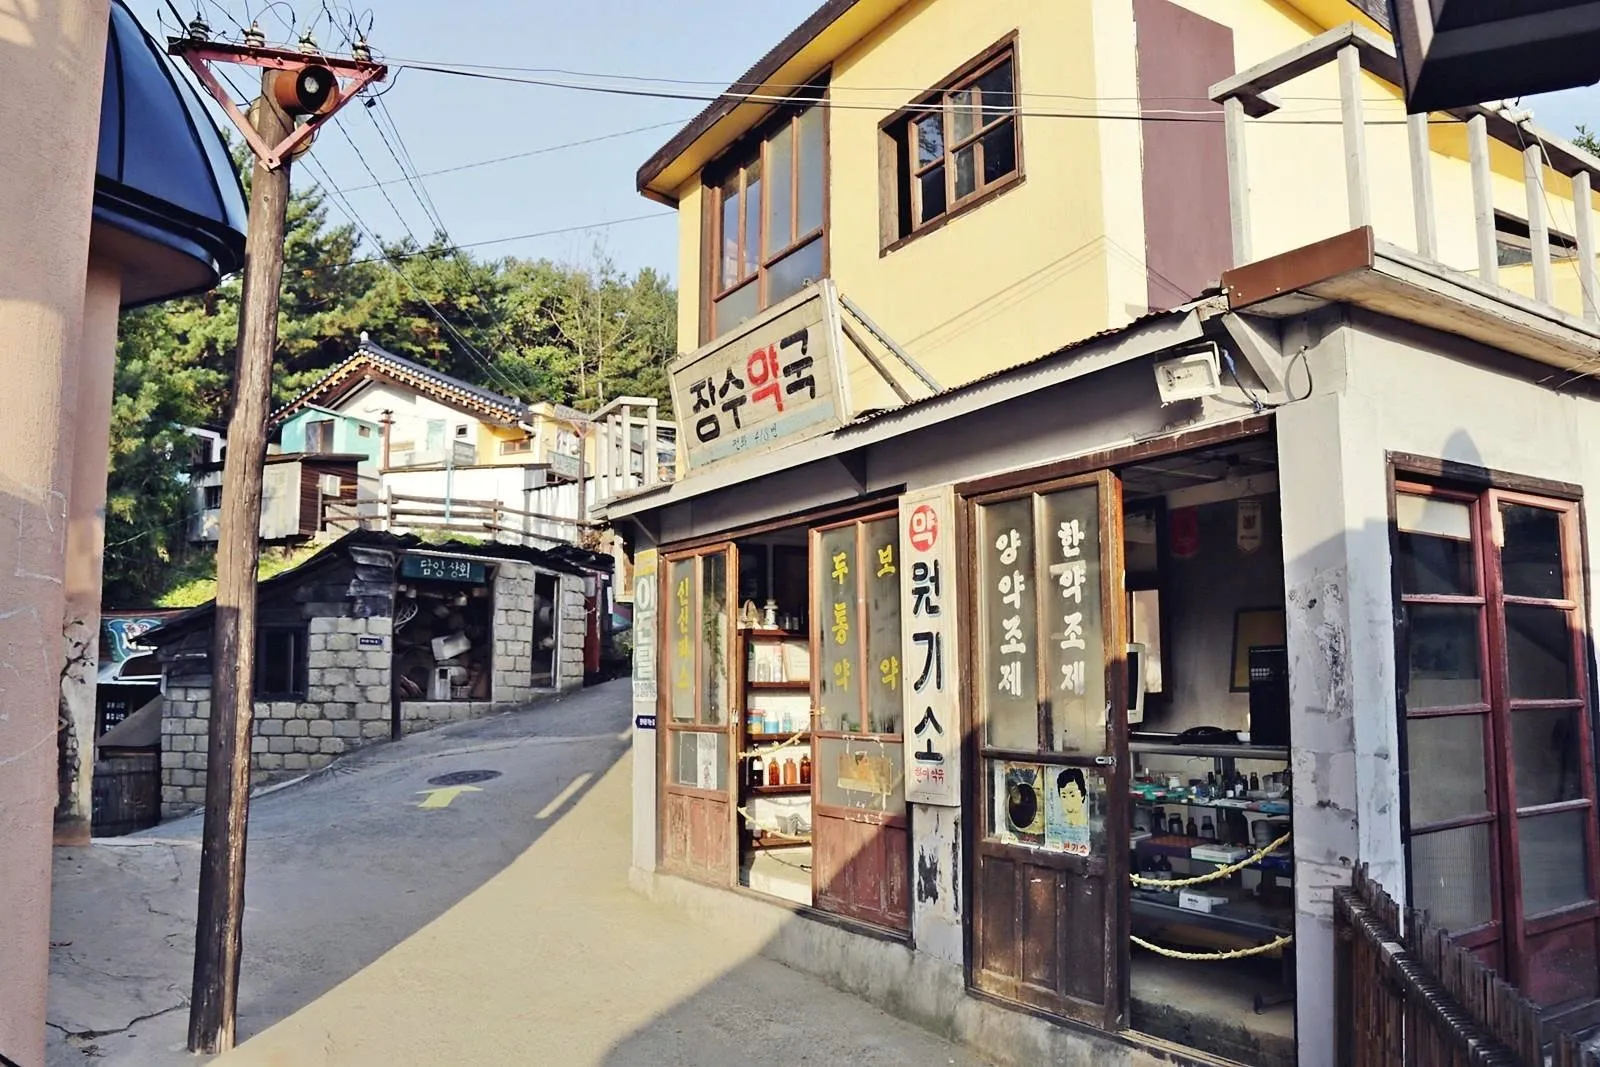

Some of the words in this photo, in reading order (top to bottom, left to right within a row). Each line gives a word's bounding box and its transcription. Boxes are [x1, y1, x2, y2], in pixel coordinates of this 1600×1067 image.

[689, 328, 816, 443] 장수약국
[420, 559, 445, 577] 담양
[449, 562, 470, 579] 상회
[912, 510, 937, 544] 약
[831, 551, 851, 690] 두통약
[877, 544, 899, 690] 보약
[911, 559, 943, 765] 원기소
[995, 528, 1026, 696] 양약조제
[1057, 519, 1087, 695] 한약조제
